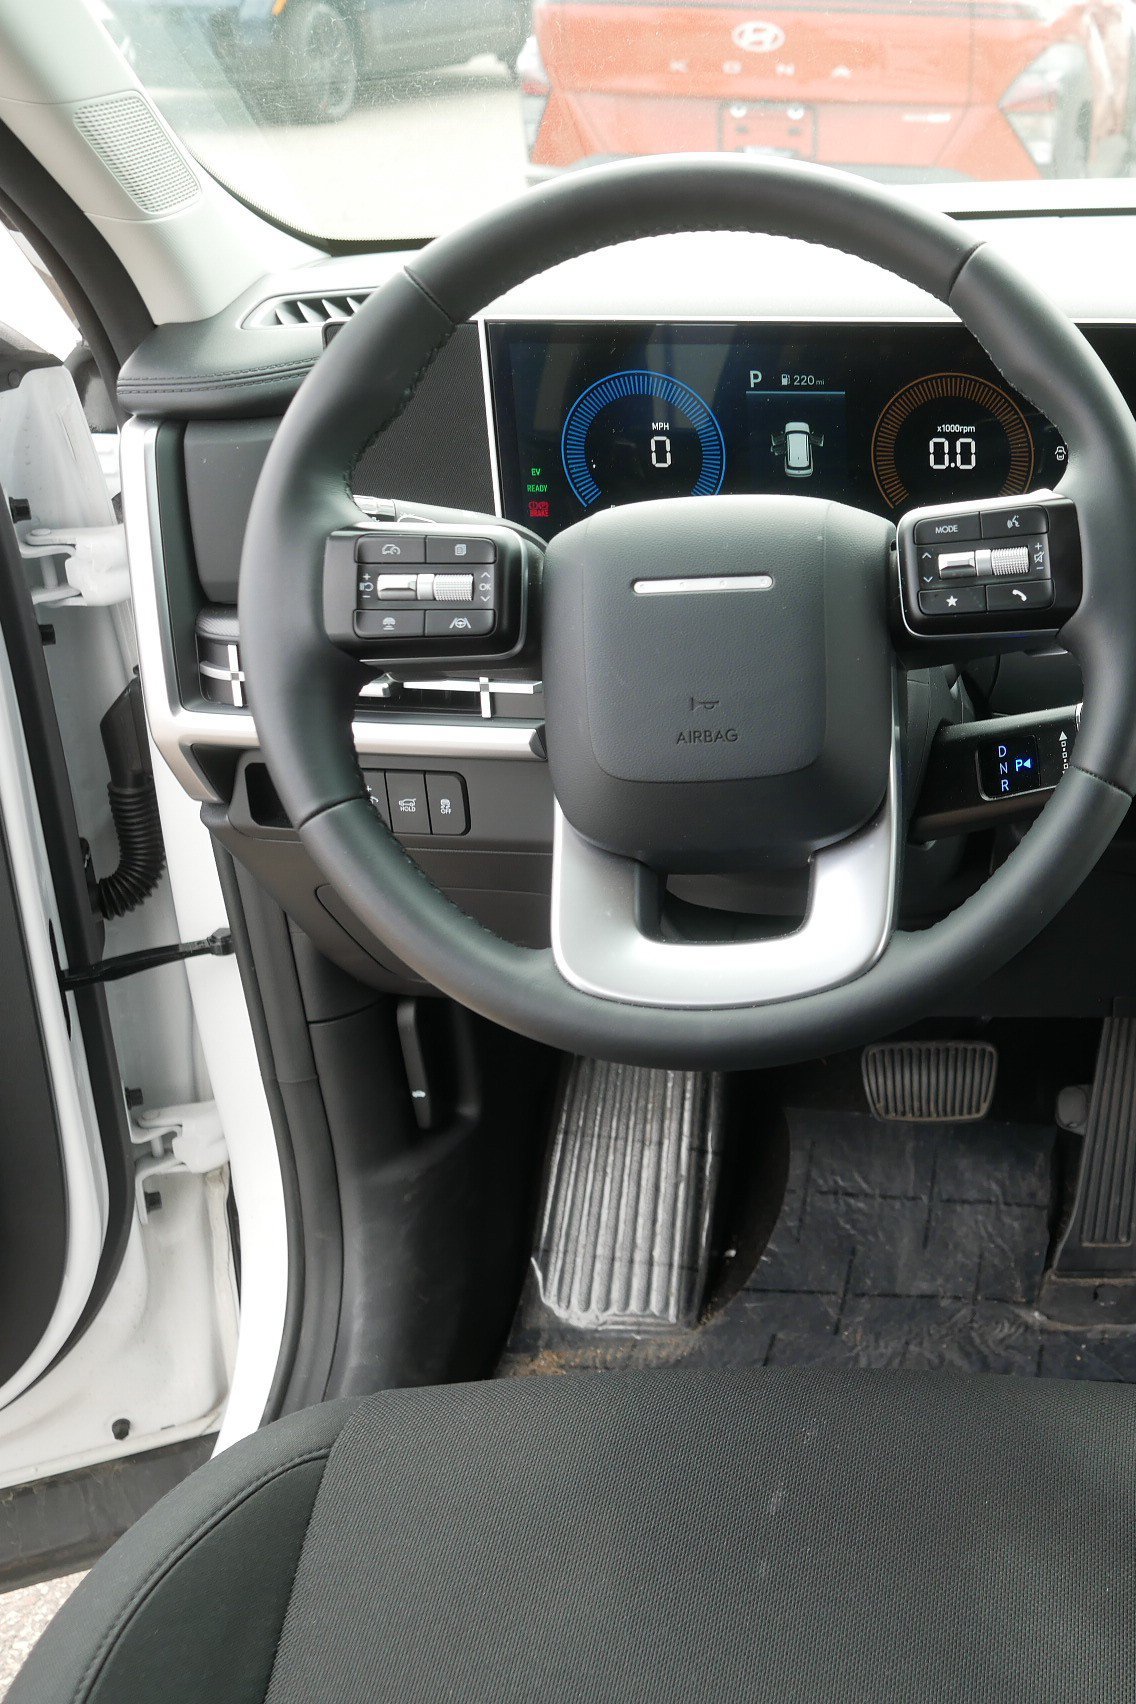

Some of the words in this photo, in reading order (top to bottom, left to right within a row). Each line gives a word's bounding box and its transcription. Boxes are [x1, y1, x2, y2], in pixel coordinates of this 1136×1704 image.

[749, 370, 763, 388] P
[793, 375, 815, 386] 220
[816, 378, 825, 386] mi
[652, 422, 670, 431] MPH
[936, 424, 976, 433] x1000rpm
[650, 436, 672, 467] 0
[928, 437, 977, 470] 0.0
[531, 468, 541, 476] EV
[526, 484, 548, 492] READY
[935, 524, 959, 534] MODE
[479, 582, 491, 591] OK
[676, 728, 738, 744] AIRBAG
[998, 745, 1007, 758] D
[999, 762, 1008, 775] N
[1015, 758, 1024, 772] P
[1001, 779, 1010, 792] R
